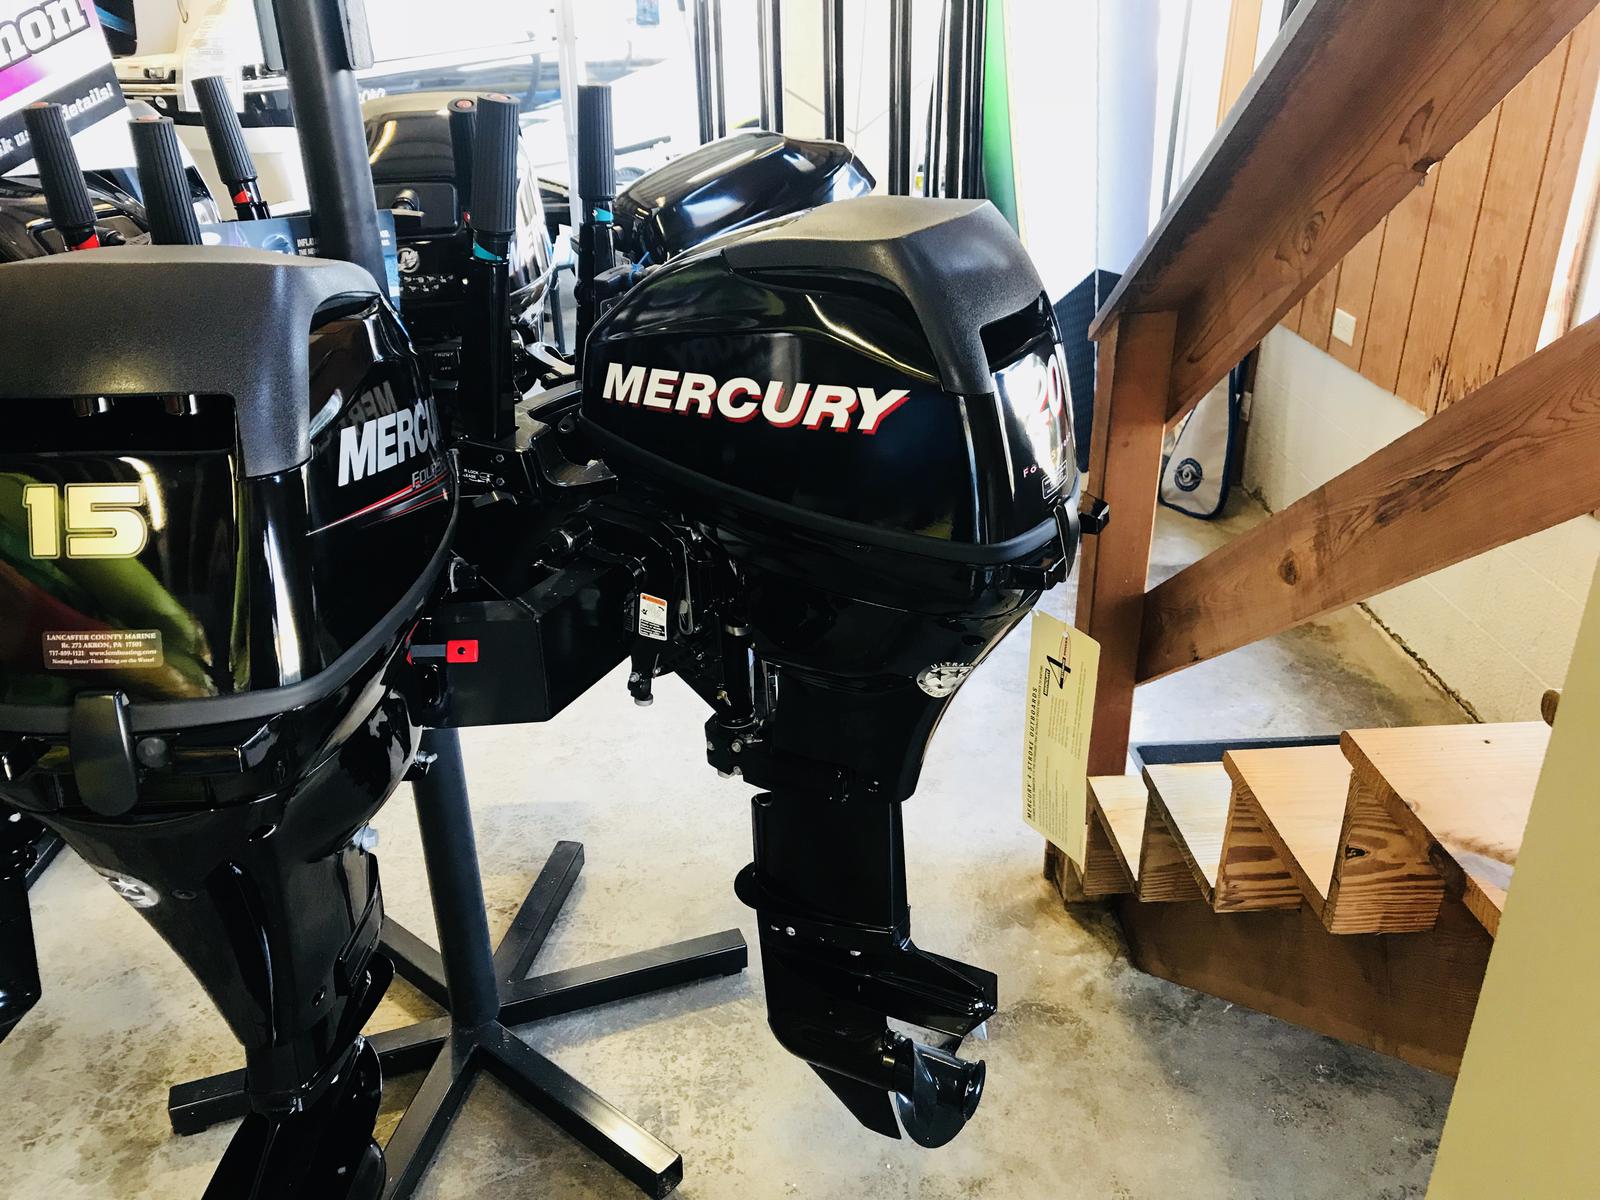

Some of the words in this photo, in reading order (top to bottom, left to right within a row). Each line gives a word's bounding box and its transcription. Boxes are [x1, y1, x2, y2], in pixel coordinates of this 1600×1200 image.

[602, 362, 911, 435] MERCURY
[22, 482, 148, 559] 15
[83, 641, 112, 649] AKRON,
[124, 632, 157, 640] MARINE
[1046, 655, 1071, 690] 4
[1029, 687, 1038, 738] OUTBOARDS
